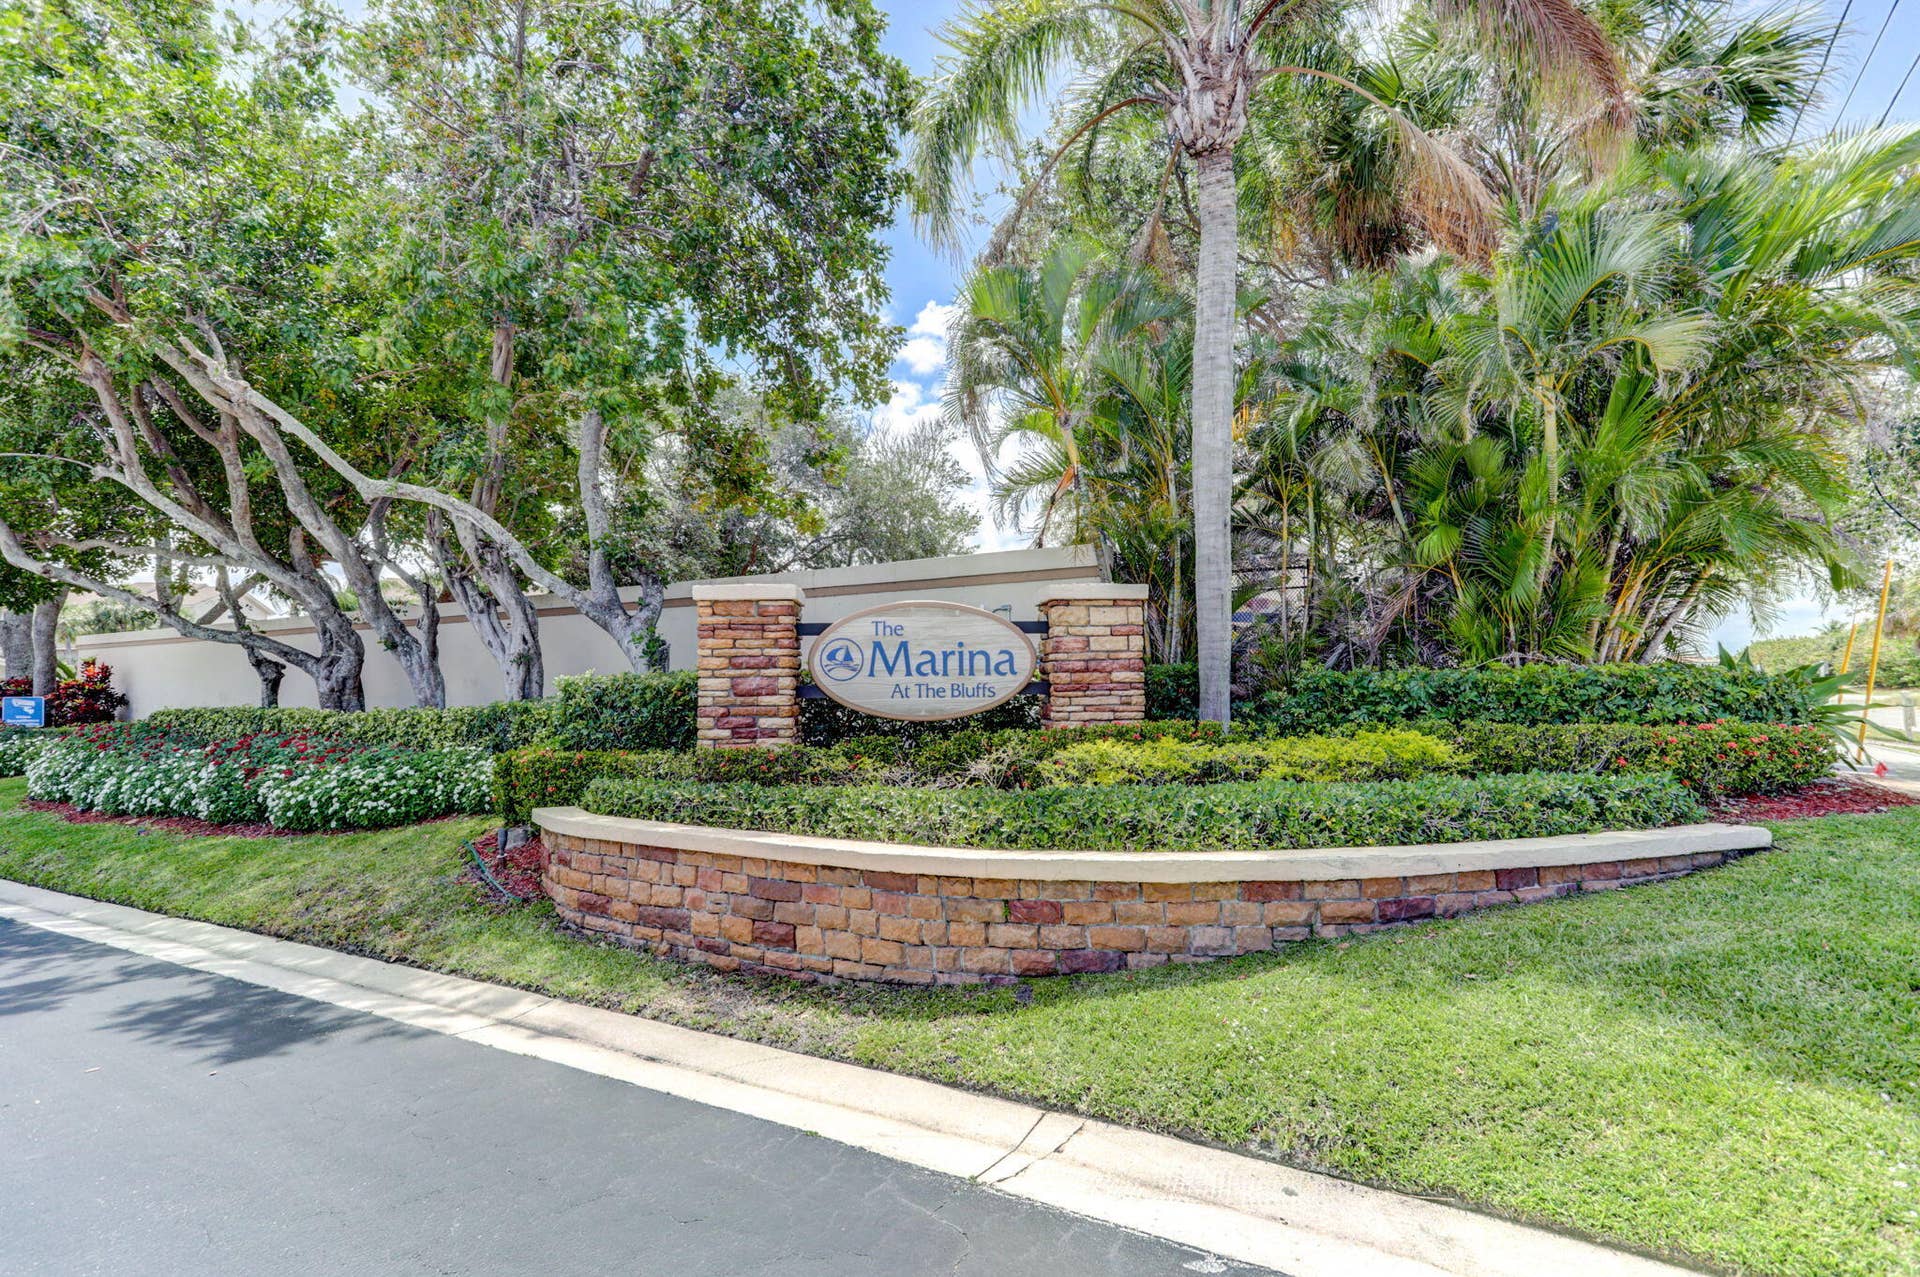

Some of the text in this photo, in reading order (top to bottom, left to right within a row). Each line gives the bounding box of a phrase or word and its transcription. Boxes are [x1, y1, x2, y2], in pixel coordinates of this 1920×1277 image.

[871, 621, 904, 636] The
[868, 640, 1018, 677] Marina
[891, 682, 996, 699] At The Bluffs
